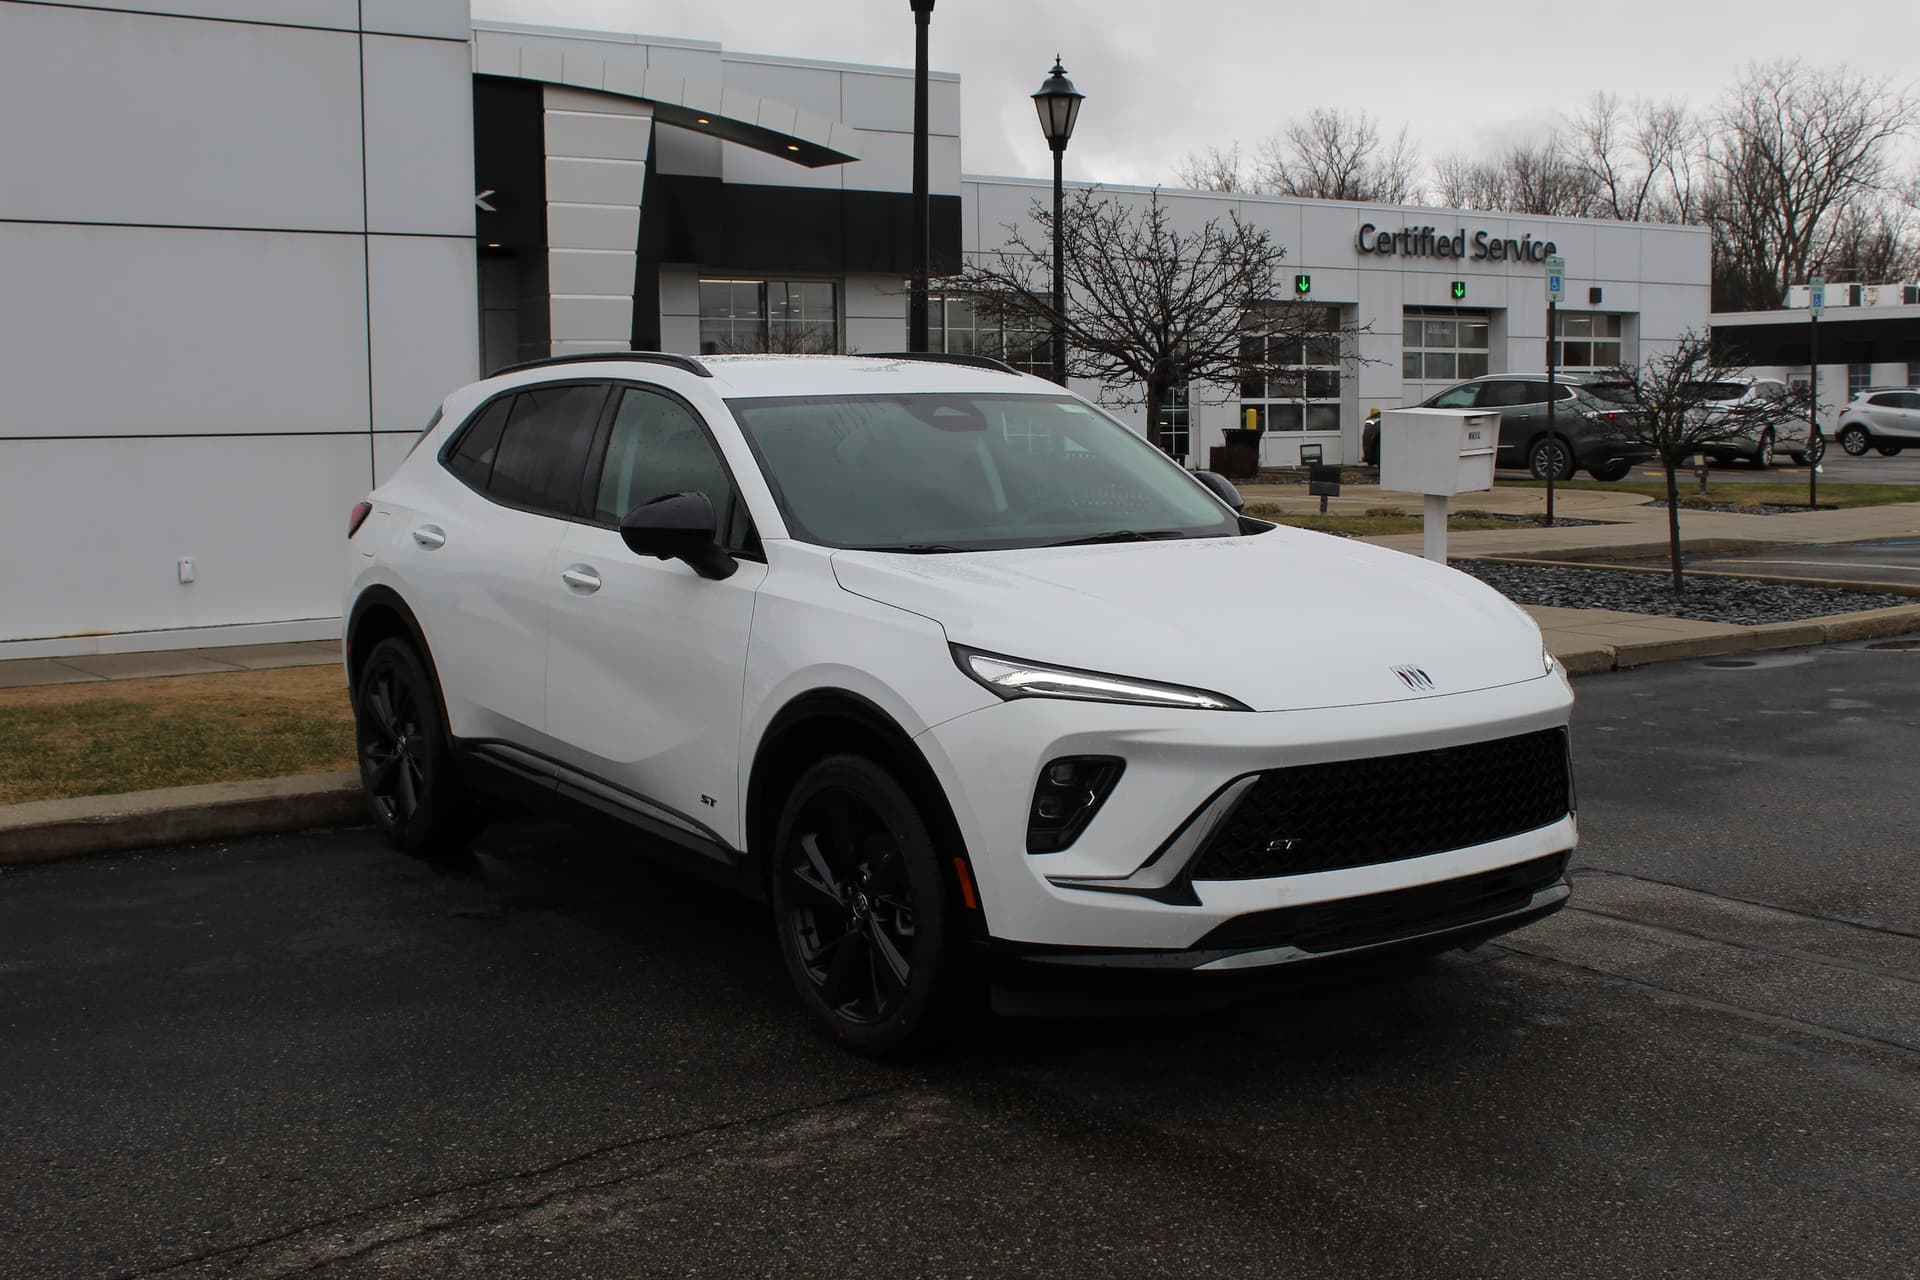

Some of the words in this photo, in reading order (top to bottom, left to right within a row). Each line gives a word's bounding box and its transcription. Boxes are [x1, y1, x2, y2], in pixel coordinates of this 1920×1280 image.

[1357, 223, 1465, 258] Certified
[1472, 231, 1557, 263] Service
[700, 794, 718, 807] ST
